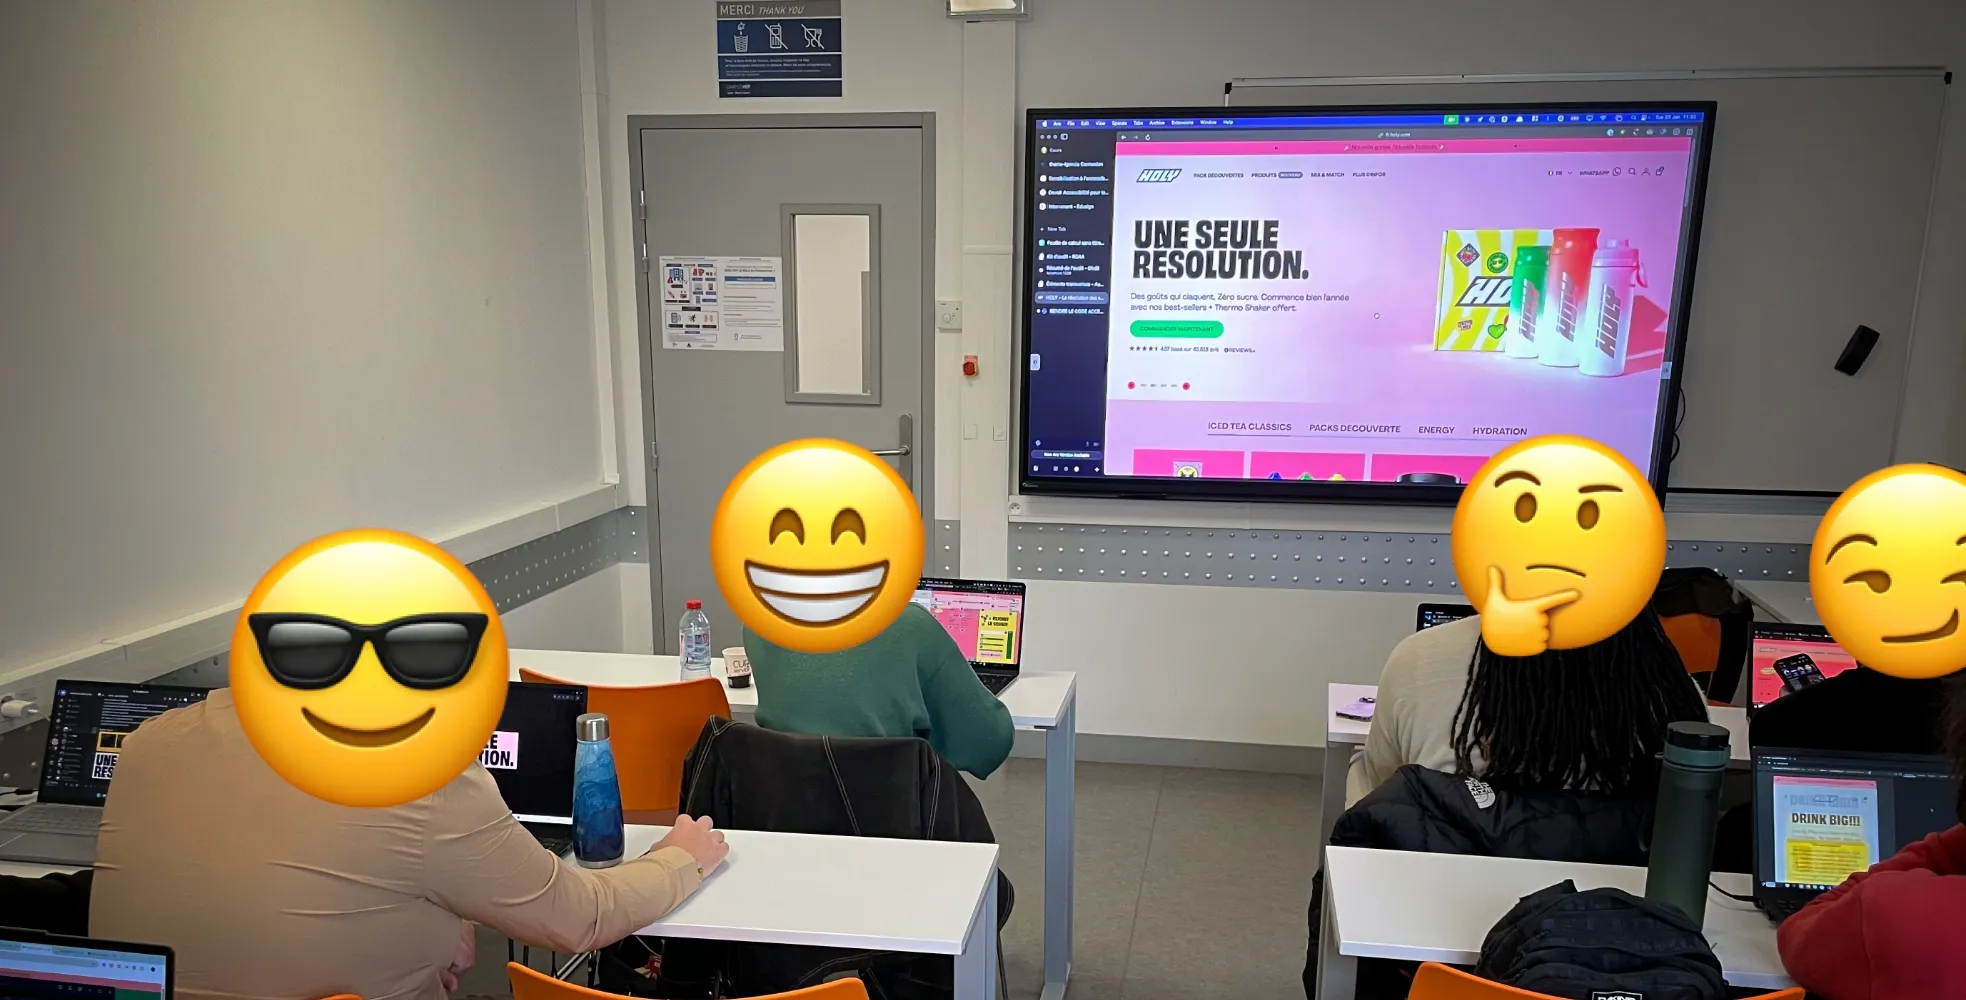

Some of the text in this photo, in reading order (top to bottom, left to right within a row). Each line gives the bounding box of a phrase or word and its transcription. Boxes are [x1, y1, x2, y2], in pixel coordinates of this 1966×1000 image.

[720, 5, 804, 15] MERCI THANK YOU
[1136, 169, 1182, 182] HOLY
[1135, 220, 1279, 249] UNE SEULE
[1147, 293, 1168, 301] goûts
[1170, 293, 1181, 301] qui
[1595, 283, 1621, 359] HOLY
[1418, 426, 1455, 434] ENERGY
[1473, 427, 1528, 436] HYDRATION
[96, 754, 117, 766] UNE
[1791, 813, 1860, 826] DRINK BIG!!!
